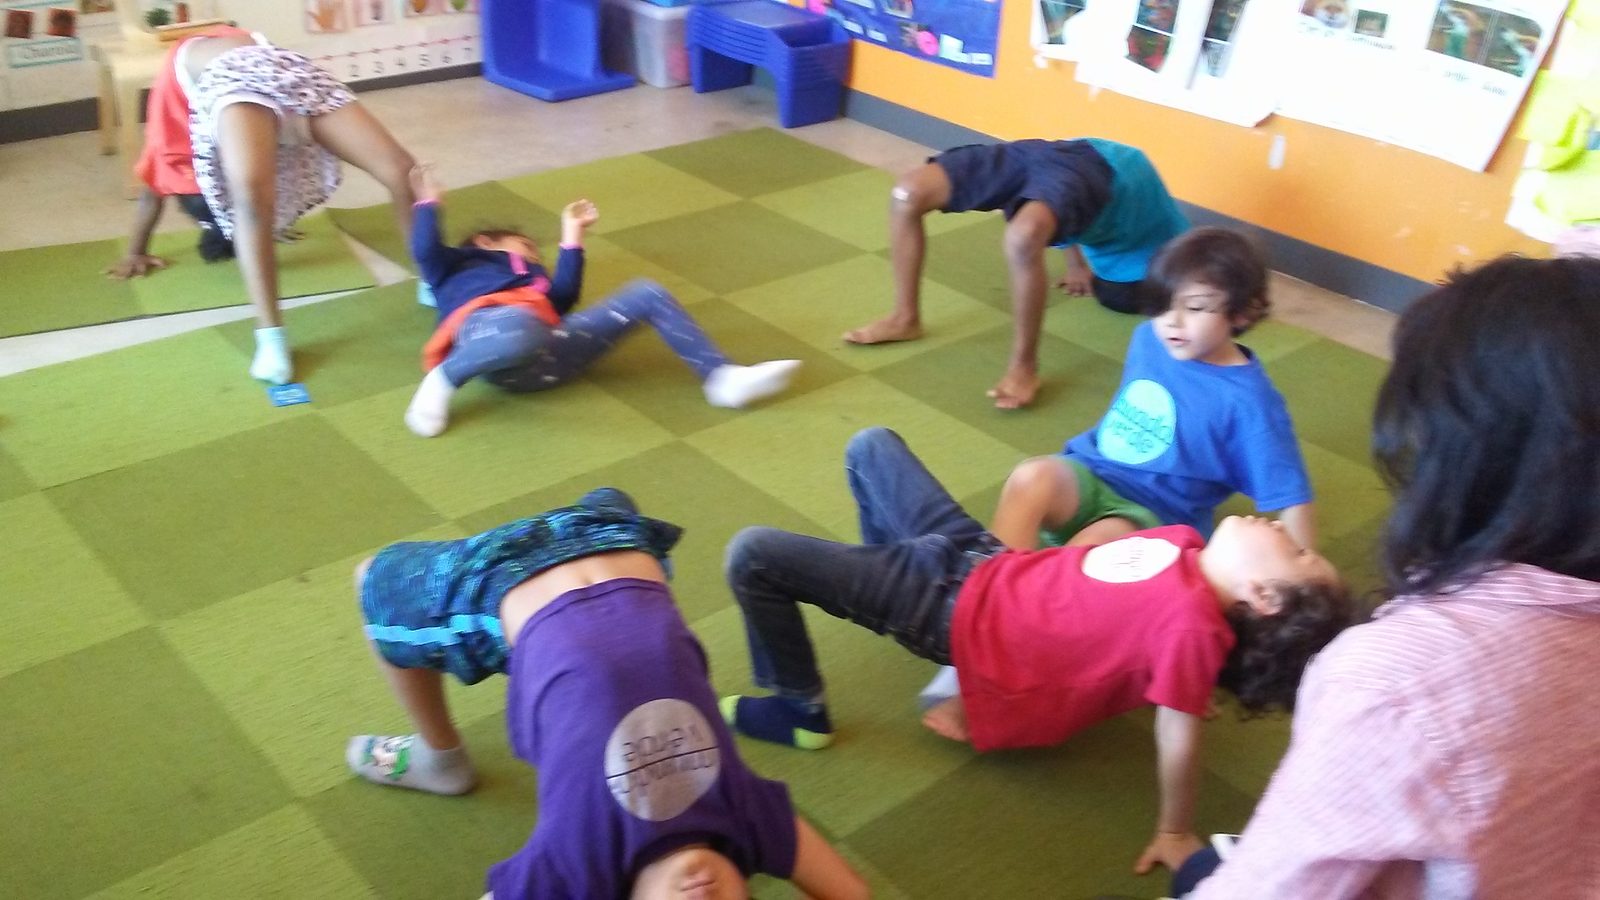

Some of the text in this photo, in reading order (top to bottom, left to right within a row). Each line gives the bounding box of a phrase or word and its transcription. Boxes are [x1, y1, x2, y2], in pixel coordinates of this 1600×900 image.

[350, 63, 360, 78] 2
[373, 61, 384, 74] 3
[420, 53, 430, 67] 5
